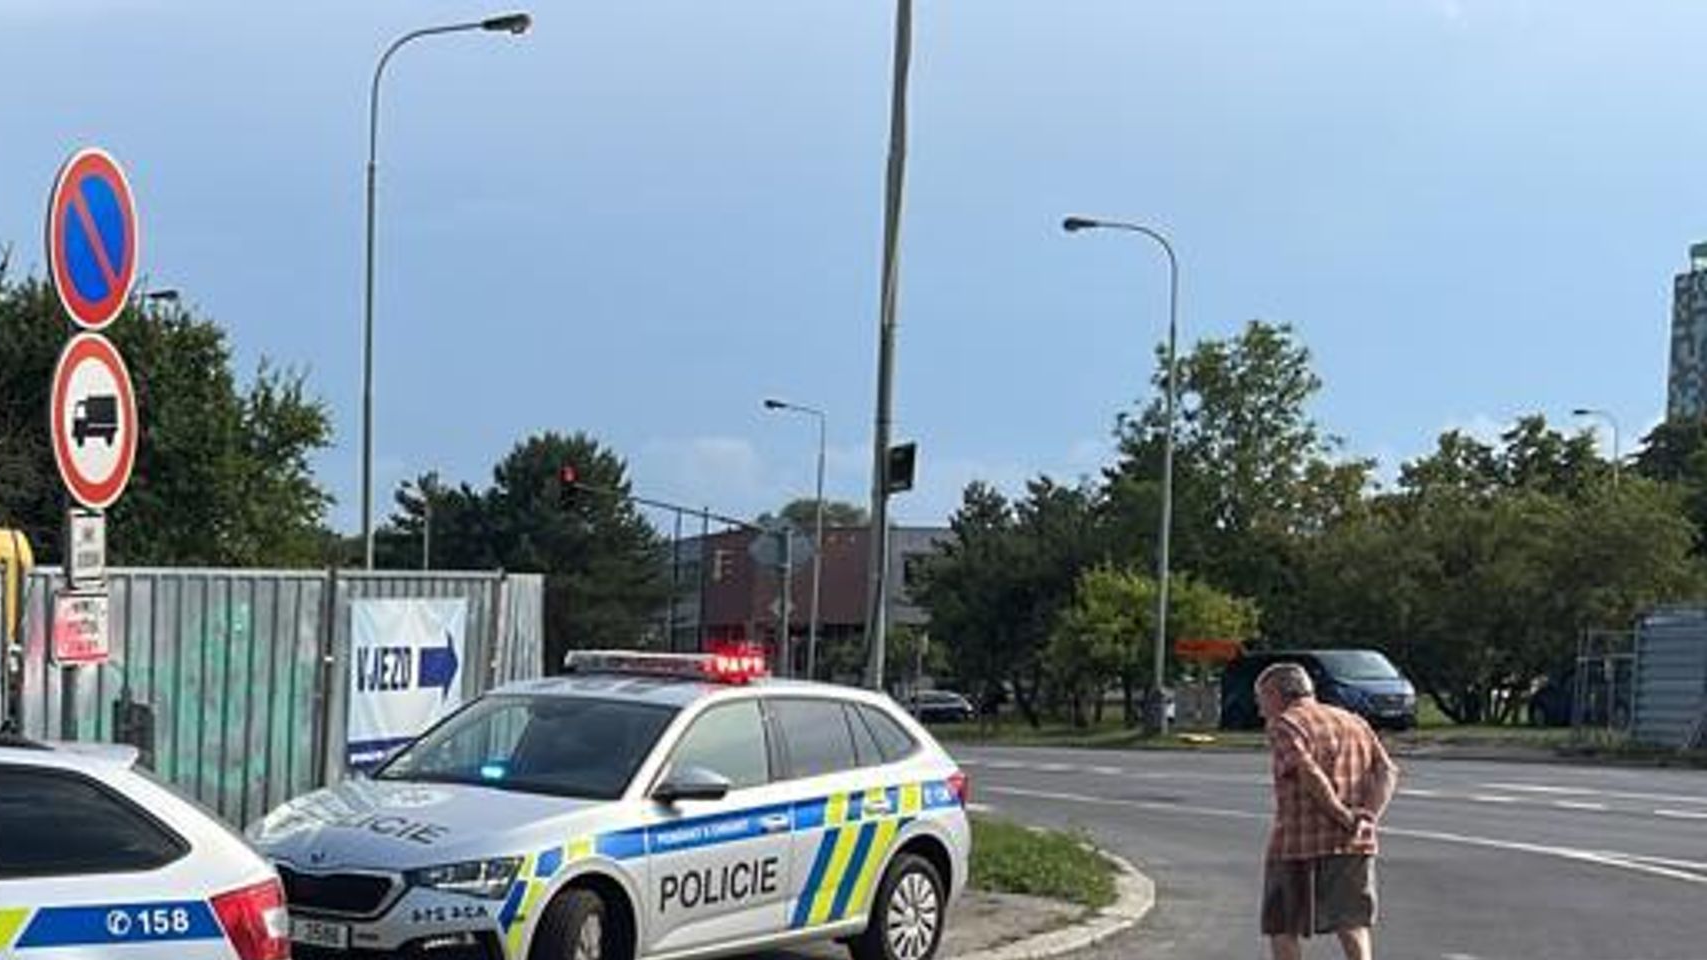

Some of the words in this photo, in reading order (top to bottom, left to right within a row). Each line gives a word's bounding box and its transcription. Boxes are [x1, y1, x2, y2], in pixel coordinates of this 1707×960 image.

[357, 646, 412, 692] VJEZD
[659, 856, 779, 914] POLICIE
[137, 907, 189, 934] 158
